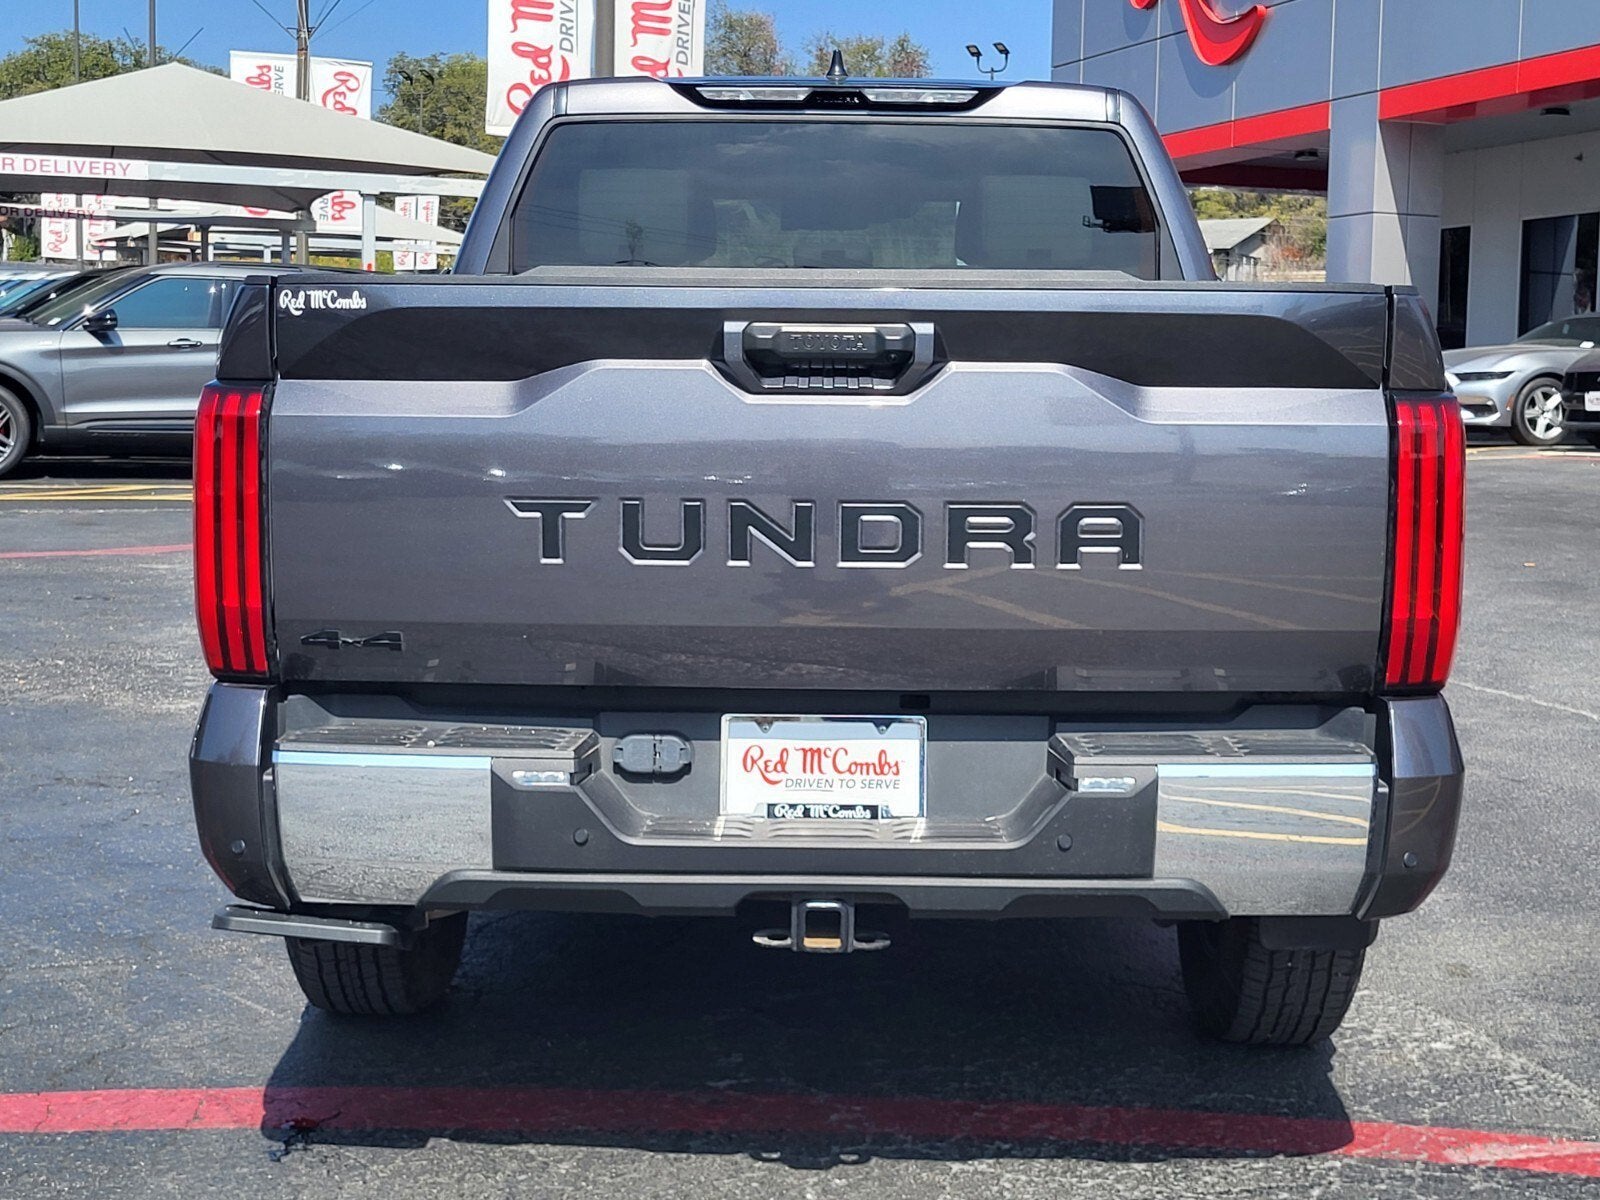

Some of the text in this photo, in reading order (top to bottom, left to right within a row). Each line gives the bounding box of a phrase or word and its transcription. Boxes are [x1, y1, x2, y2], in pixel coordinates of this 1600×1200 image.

[559, 0, 575, 53] DRIV
[675, 0, 691, 66] DRIVE
[274, 65, 284, 95] ERVE
[23, 158, 131, 176] DELIVERY
[319, 197, 328, 221] RVE
[280, 289, 367, 316] Red McCombs
[790, 334, 868, 351] TOYOTA
[503, 499, 1145, 570] TUNDRA
[742, 745, 900, 785] Red McCombs
[785, 778, 900, 790] DRIVEN TO SERVE
[774, 804, 802, 819] Red
